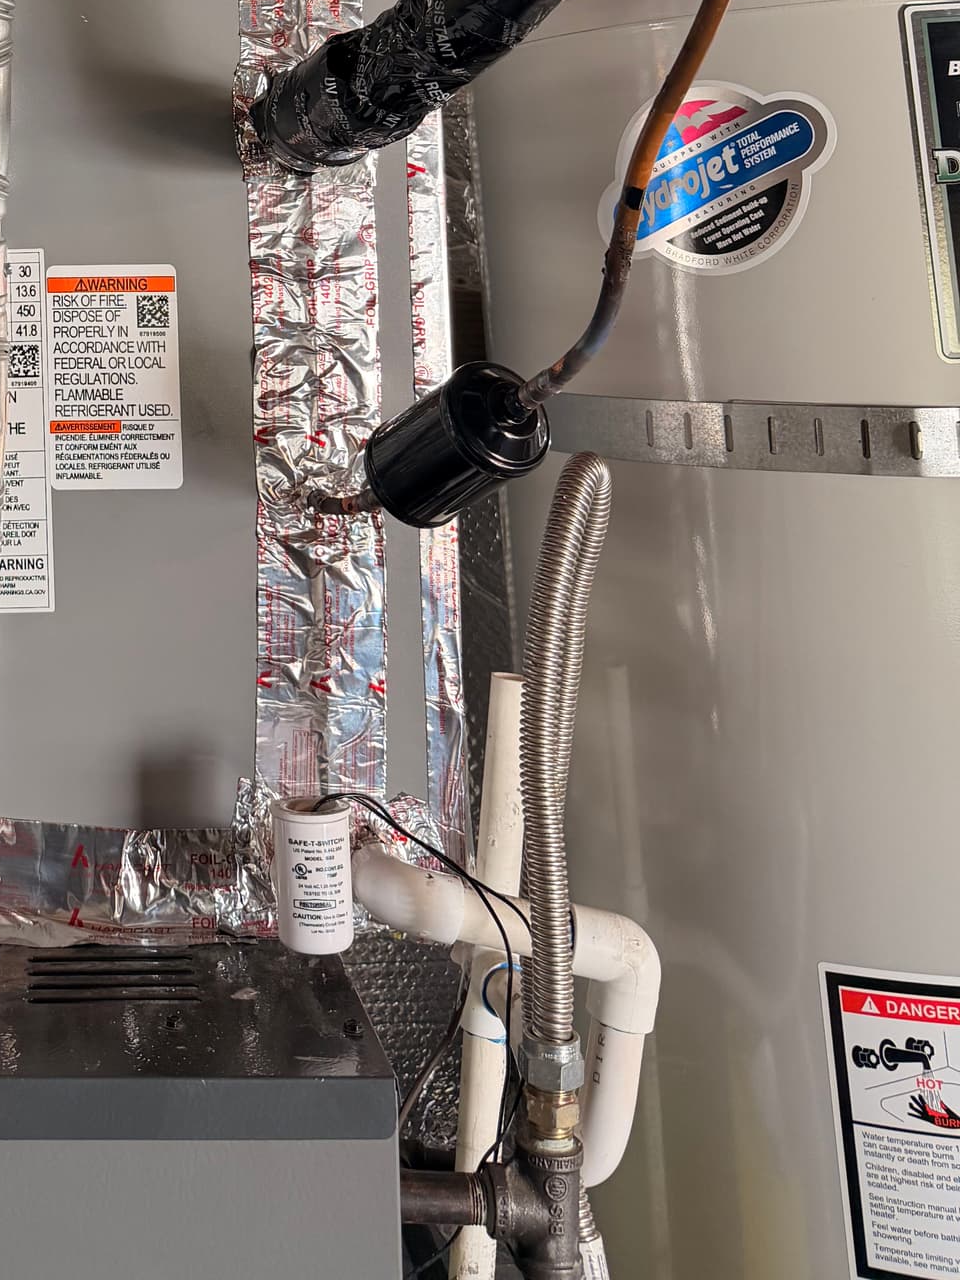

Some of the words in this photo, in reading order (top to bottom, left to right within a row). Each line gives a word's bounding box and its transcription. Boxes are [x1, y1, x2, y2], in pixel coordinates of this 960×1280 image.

[710, 121, 741, 141] WITH
[736, 130, 762, 149] TOTAL
[740, 121, 800, 158] PERFORMANCE
[744, 145, 777, 169] SYSTEM
[641, 144, 739, 226] ydrojet
[688, 184, 756, 223] FEATURING
[723, 247, 756, 265] WHITE
[757, 183, 800, 251] CORPORATION
[19, 266, 31, 277] 30
[16, 285, 36, 297] 13.6
[89, 279, 148, 291] WARNING
[53, 295, 79, 307] RISK
[81, 295, 98, 306] OF
[99, 295, 127, 306] FIRE.
[17, 305, 35, 317] 450
[53, 311, 106, 322] DISPOSE
[108, 311, 121, 322] OF
[16, 324, 37, 336] 41.8
[53, 327, 115, 338] PROPERLY
[118, 326, 128, 337] IN
[54, 342, 135, 354] ACCORDANCE
[137, 341, 166, 353] WITH
[54, 358, 106, 369] FEDERAL
[109, 357, 126, 369] OR
[128, 357, 165, 369] LOCAL
[55, 373, 138, 385] REGULATIONS.
[55, 389, 124, 401] FLAMMABLE
[55, 404, 136, 417] REFRIGERANT
[139, 404, 173, 416] USED.
[14, 538, 21, 546] LA
[0, 558, 43, 571] ARNING
[916, 1078, 943, 1090] HOT
[862, 1131, 885, 1142] Water
[887, 1136, 934, 1149] temperature
[879, 1144, 902, 1153] cause
[904, 1149, 930, 1157] severe
[932, 1151, 954, 1160] burns
[907, 1156, 929, 1166] death
[931, 1160, 949, 1168] from
[881, 1173, 888, 1181] at
[891, 1175, 919, 1186] highest
[921, 1180, 934, 1189] risk
[936, 1182, 943, 1190] of
[902, 1169, 934, 1180] disabled
[936, 1174, 951, 1182] and
[868, 1192, 884, 1202] See
[886, 1197, 926, 1210] instruction
[928, 1204, 957, 1214] manual
[870, 1202, 895, 1213] setting
[897, 1206, 944, 1220] temperature
[946, 1213, 953, 1221] at
[871, 1221, 889, 1231] Feel
[891, 1225, 912, 1235] water
[914, 1228, 939, 1240] before
[872, 1230, 912, 1245] showering
[874, 1243, 924, 1259] Temperature
[925, 1253, 957, 1265] limiting
[914, 1260, 928, 1269] see
